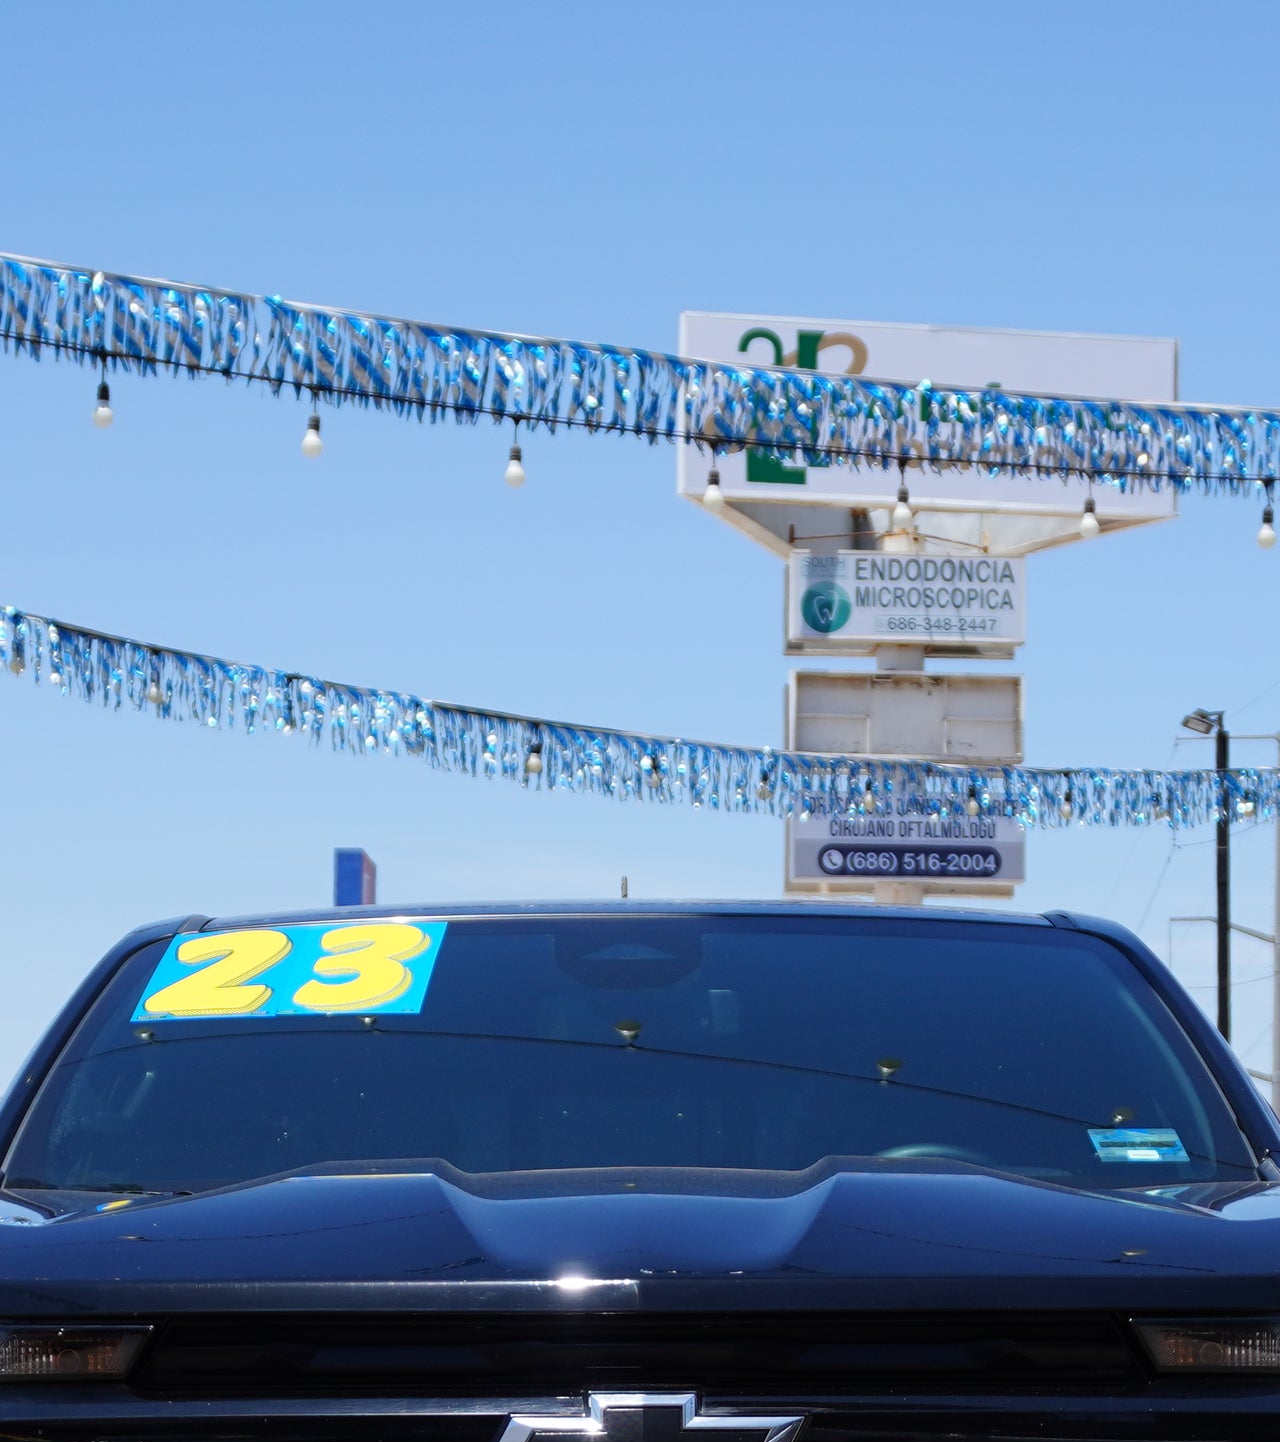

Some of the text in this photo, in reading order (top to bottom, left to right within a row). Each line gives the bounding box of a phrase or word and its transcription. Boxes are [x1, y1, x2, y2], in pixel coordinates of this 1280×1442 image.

[855, 558, 1015, 584] ENDODONCIA
[855, 586, 1014, 610] MICROSCOPICA
[887, 616, 998, 632] 686-348-2447
[830, 819, 895, 838] CIRUJANO
[846, 851, 997, 872] (686) 516-2004
[144, 923, 432, 1017] 23
